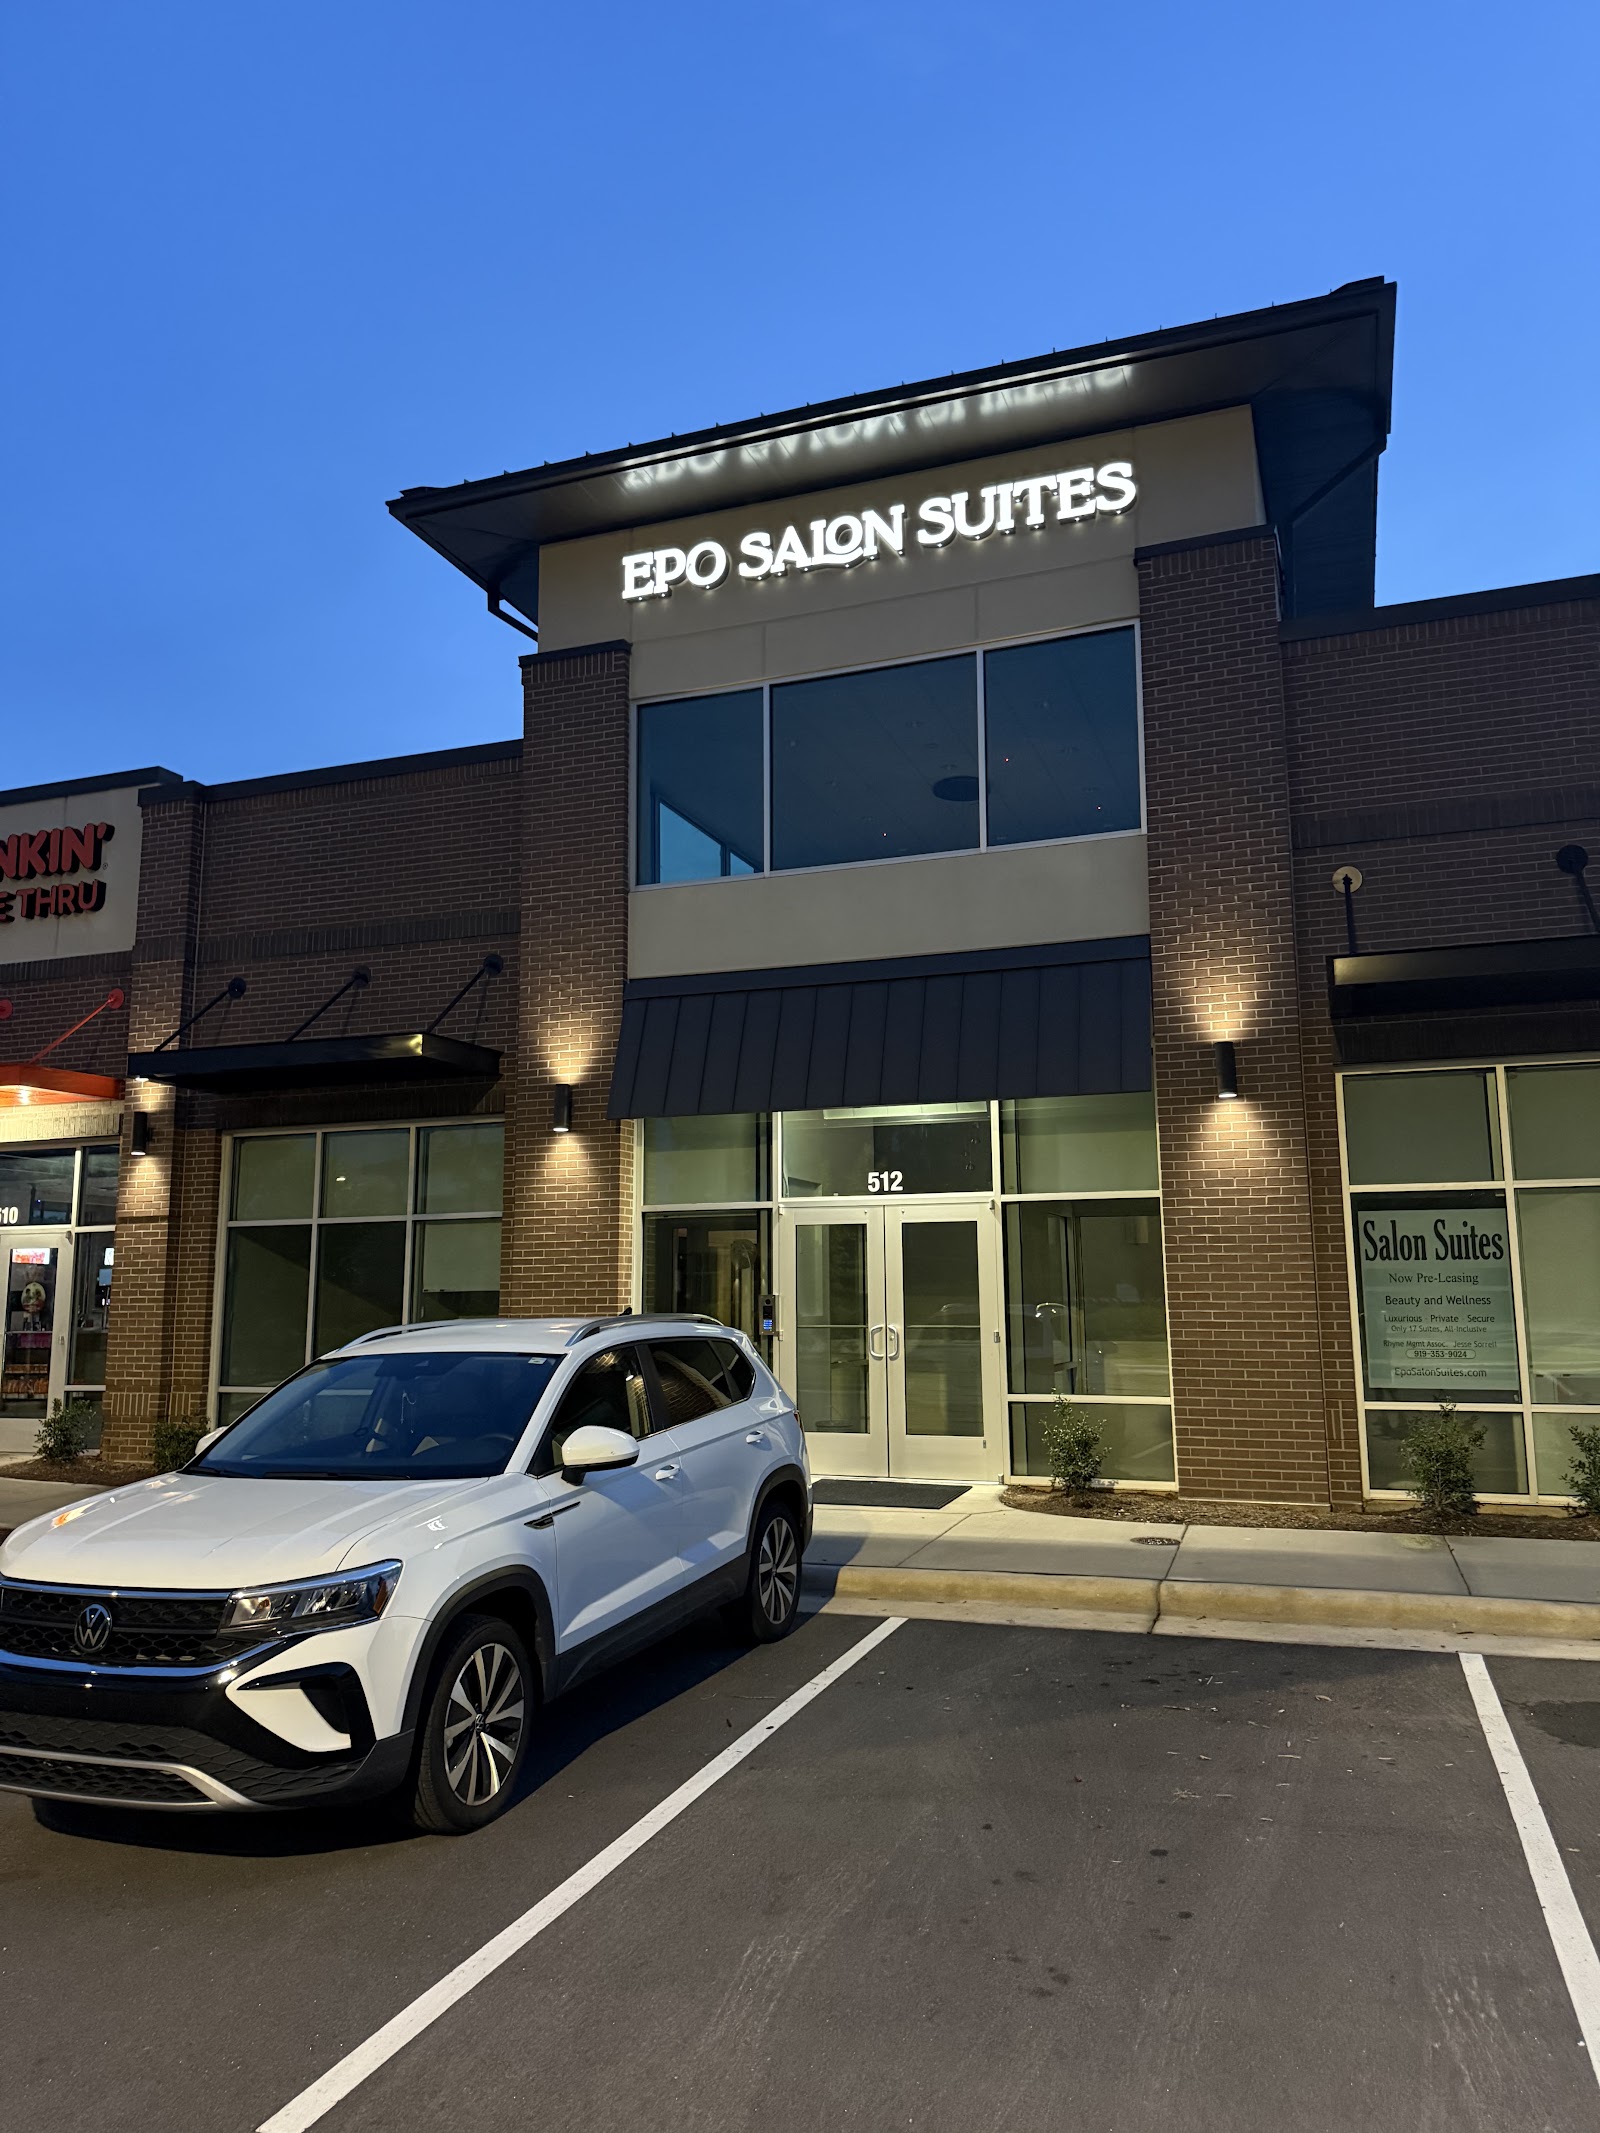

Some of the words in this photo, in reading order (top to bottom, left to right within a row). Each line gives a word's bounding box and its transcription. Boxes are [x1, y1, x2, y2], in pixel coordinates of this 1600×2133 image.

[622, 541, 729, 602] EPO
[738, 504, 906, 580] SALON
[917, 461, 1137, 548] SUITES
[16, 879, 104, 919] THRU
[867, 1171, 903, 1192] 512
[0, 1206, 19, 1224] 10
[1363, 1219, 1427, 1261] Salon
[1433, 1218, 1504, 1261] Suites
[1389, 1273, 1413, 1283] Now
[1417, 1273, 1479, 1285] Pre-Leasing
[1385, 1295, 1421, 1307] Beauty
[1424, 1295, 1443, 1305] and
[1446, 1295, 1491, 1305] Wellness
[1384, 1314, 1423, 1323] Luxurious
[1430, 1314, 1459, 1323] Private
[1467, 1314, 1495, 1323] Secure
[1391, 1325, 1407, 1333] Only
[1406, 1340, 1425, 1348] Mgmt
[1453, 1340, 1472, 1348] Jesse
[1414, 1350, 1467, 1358] 919-353-9024
